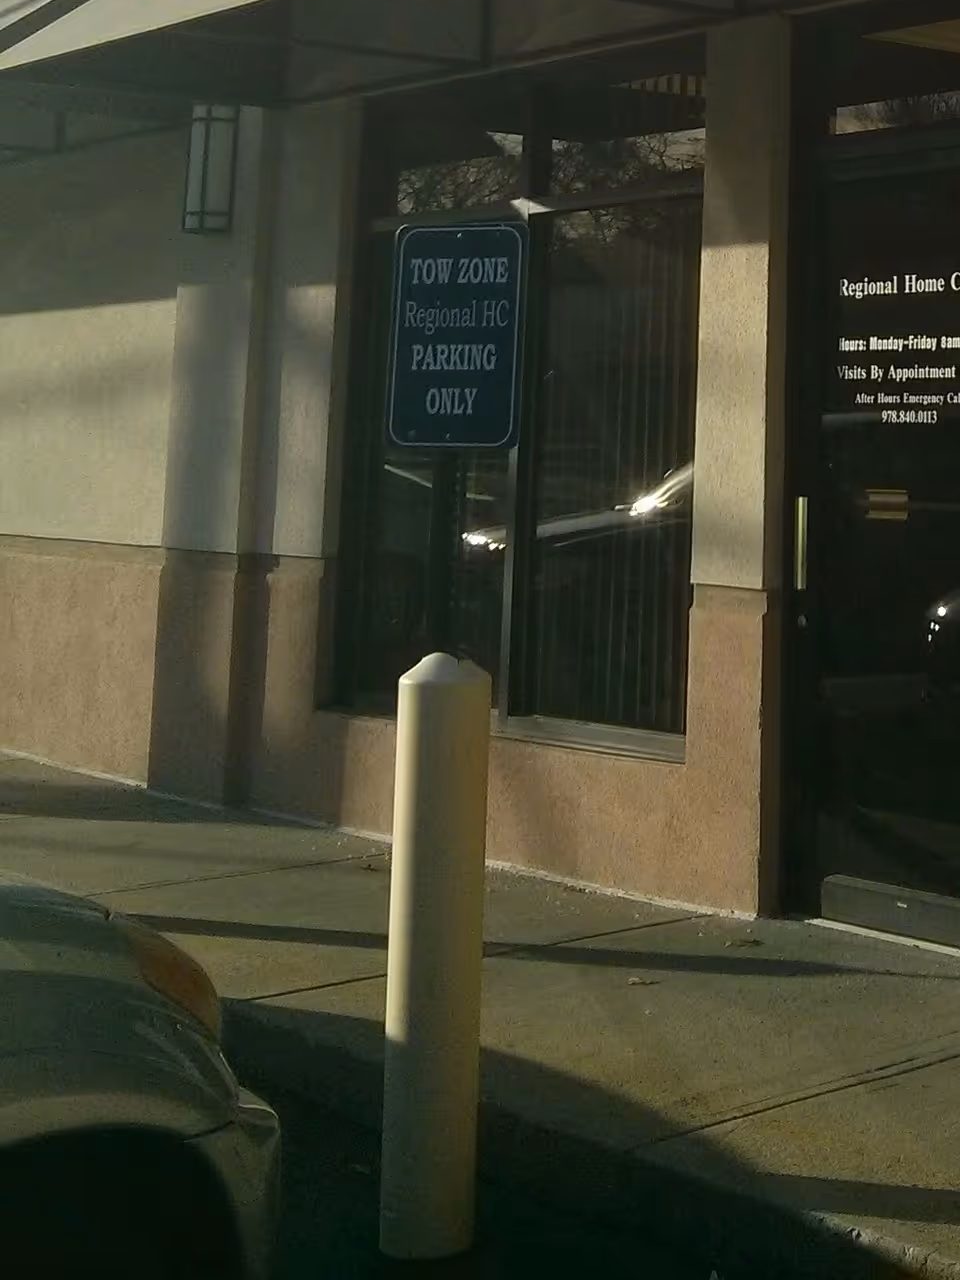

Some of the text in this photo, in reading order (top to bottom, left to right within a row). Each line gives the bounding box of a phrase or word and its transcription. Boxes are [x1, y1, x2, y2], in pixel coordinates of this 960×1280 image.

[410, 257, 509, 284] TOW ZONE
[839, 276, 898, 299] Regional
[904, 274, 945, 293] Home
[404, 300, 510, 335] Regional HC
[839, 337, 867, 351] Hours:
[869, 335, 937, 351] Monday-Friday
[411, 344, 497, 370] PARKING
[837, 365, 867, 380] Visits
[870, 365, 884, 381] By
[888, 364, 956, 382] Appointment
[426, 387, 478, 414] ONLY
[855, 393, 875, 404] After
[877, 392, 901, 403] Hours
[903, 392, 944, 405] Emergency
[881, 410, 938, 423] 978.840.0113
